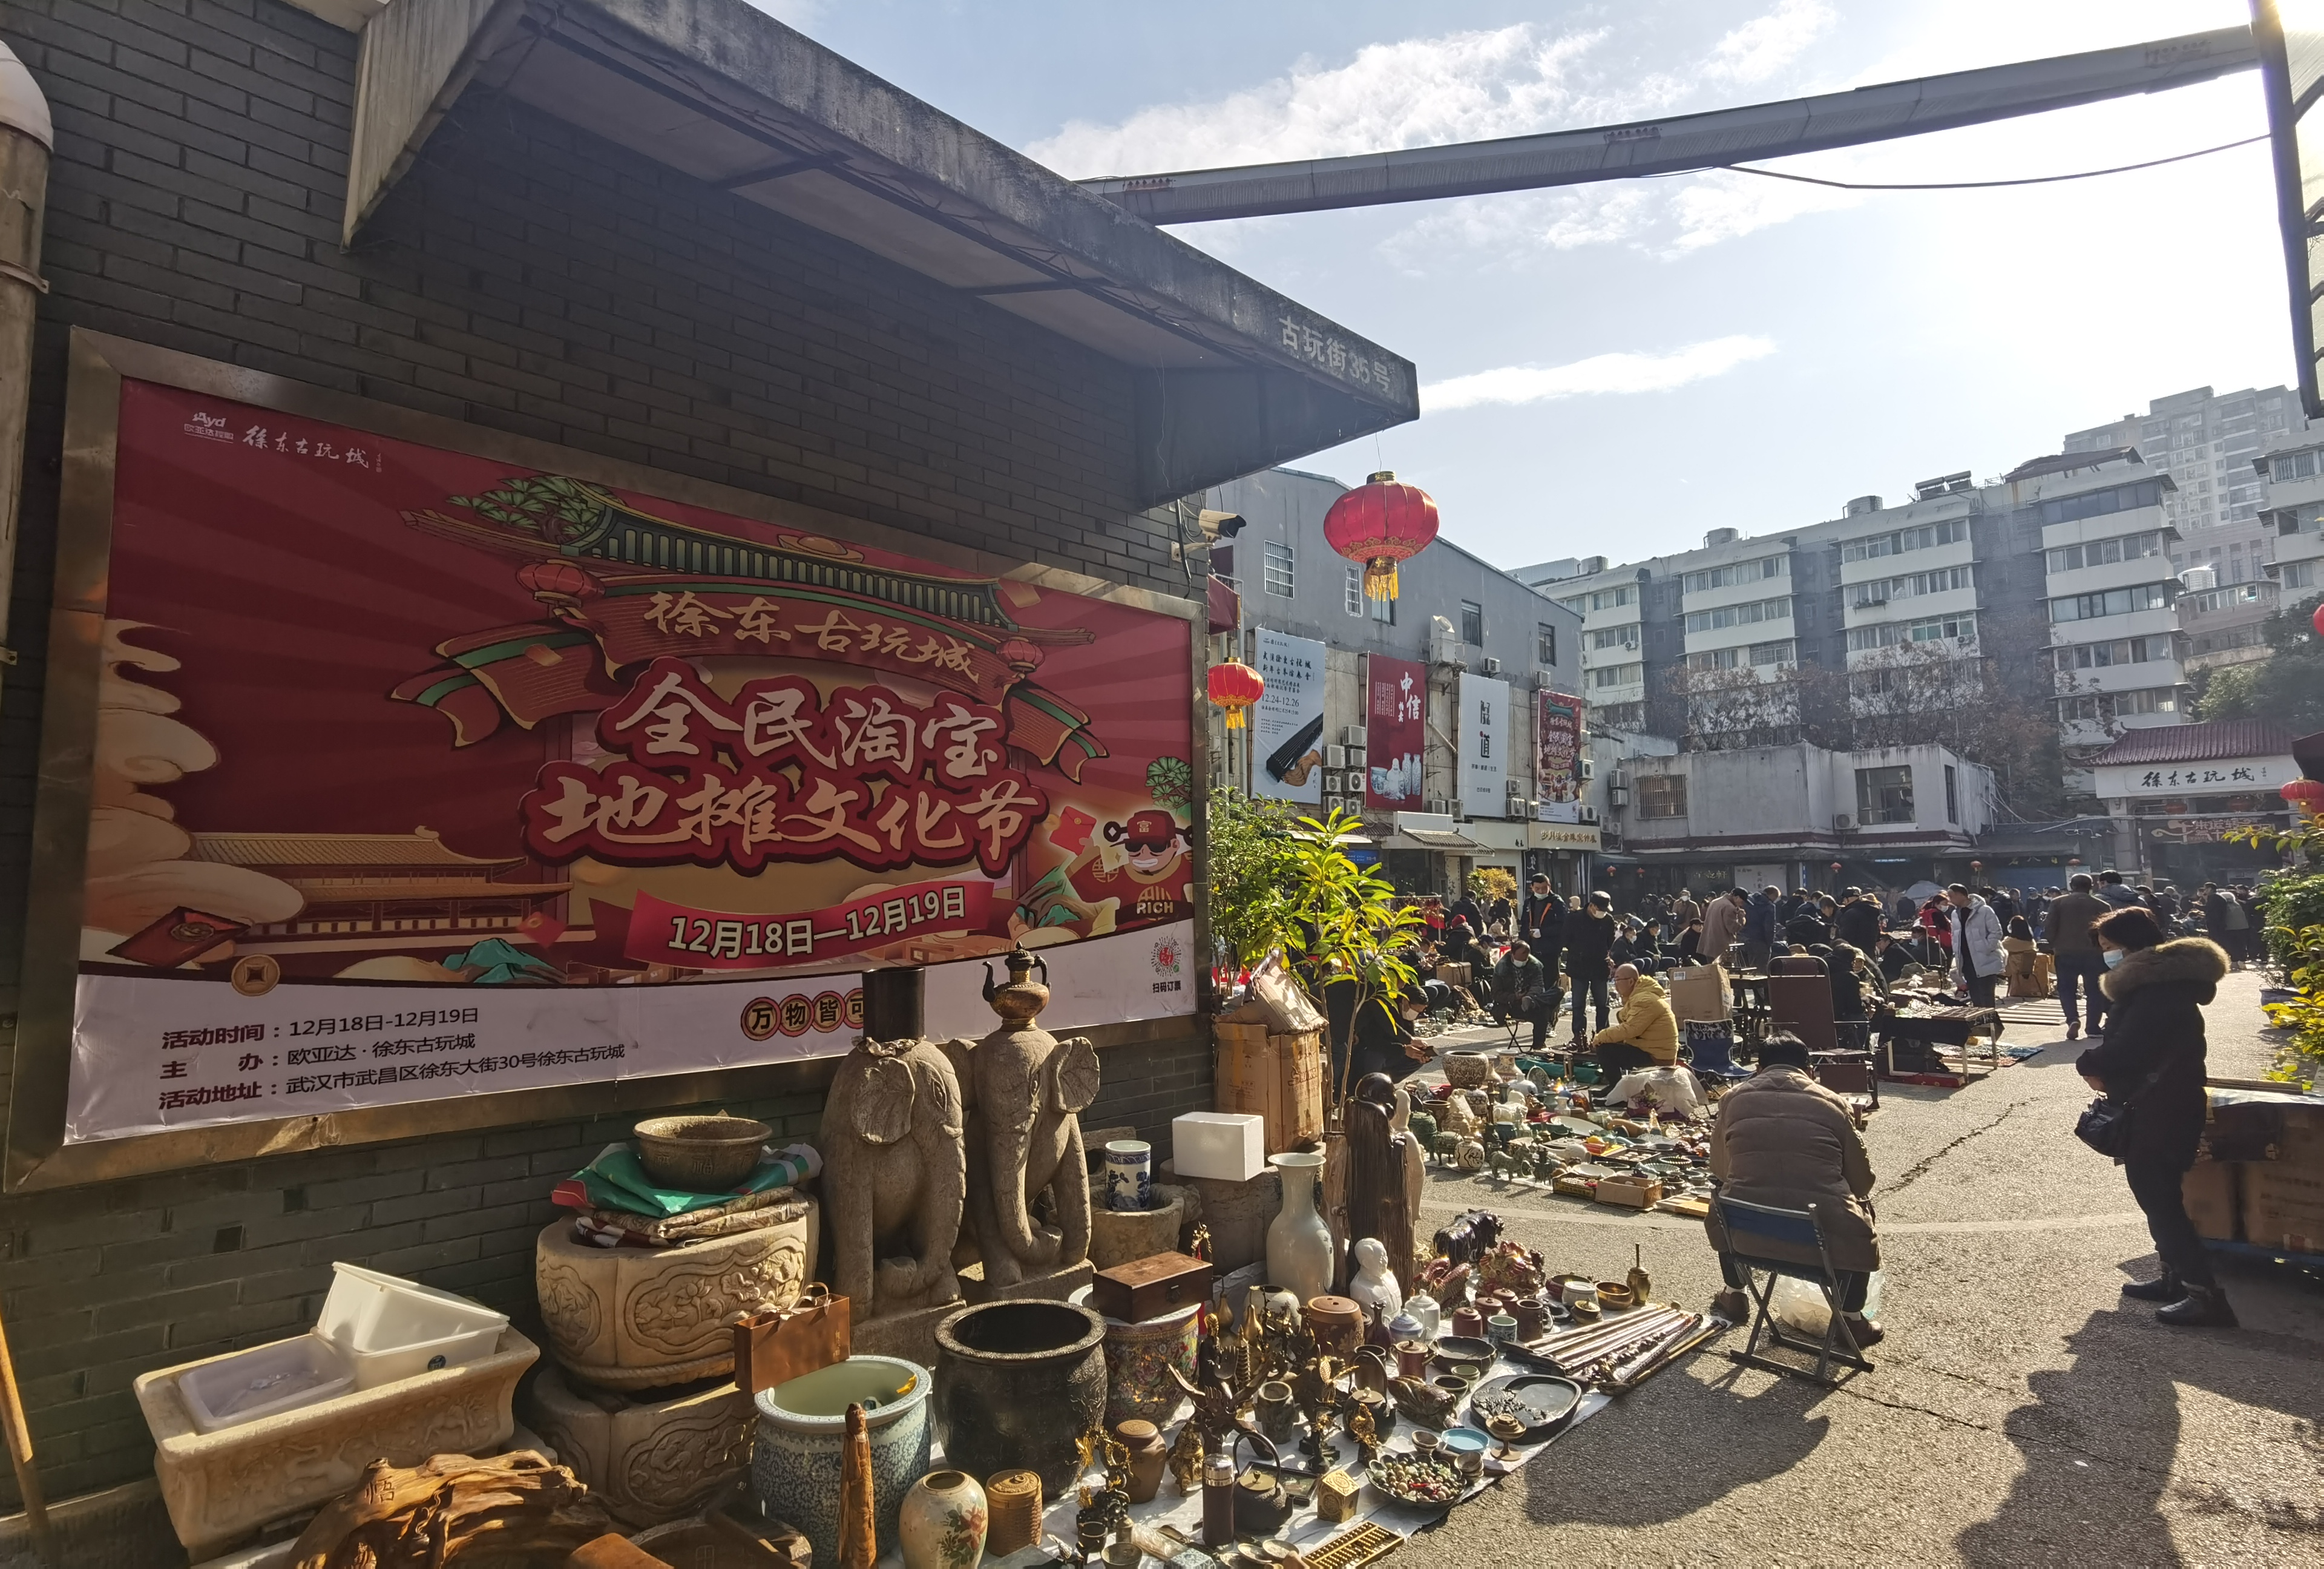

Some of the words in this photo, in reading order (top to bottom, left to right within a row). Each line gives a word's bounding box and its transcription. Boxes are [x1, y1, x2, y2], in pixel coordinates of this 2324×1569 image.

[243, 426, 369, 469] 徐东古玩城
[643, 590, 980, 684] 徐东古玩城
[1262, 694, 1299, 707] 12.24-12.26
[615, 672, 999, 778] 全民淘宝
[2141, 767, 2254, 788] 徐东古玩城
[540, 774, 1039, 861] 地摊文化节
[1137, 820, 1152, 833] 富
[1137, 901, 1173, 914] RICH
[1152, 980, 1181, 993] 扫码订票
[366, 1475, 395, 1504] 悟
